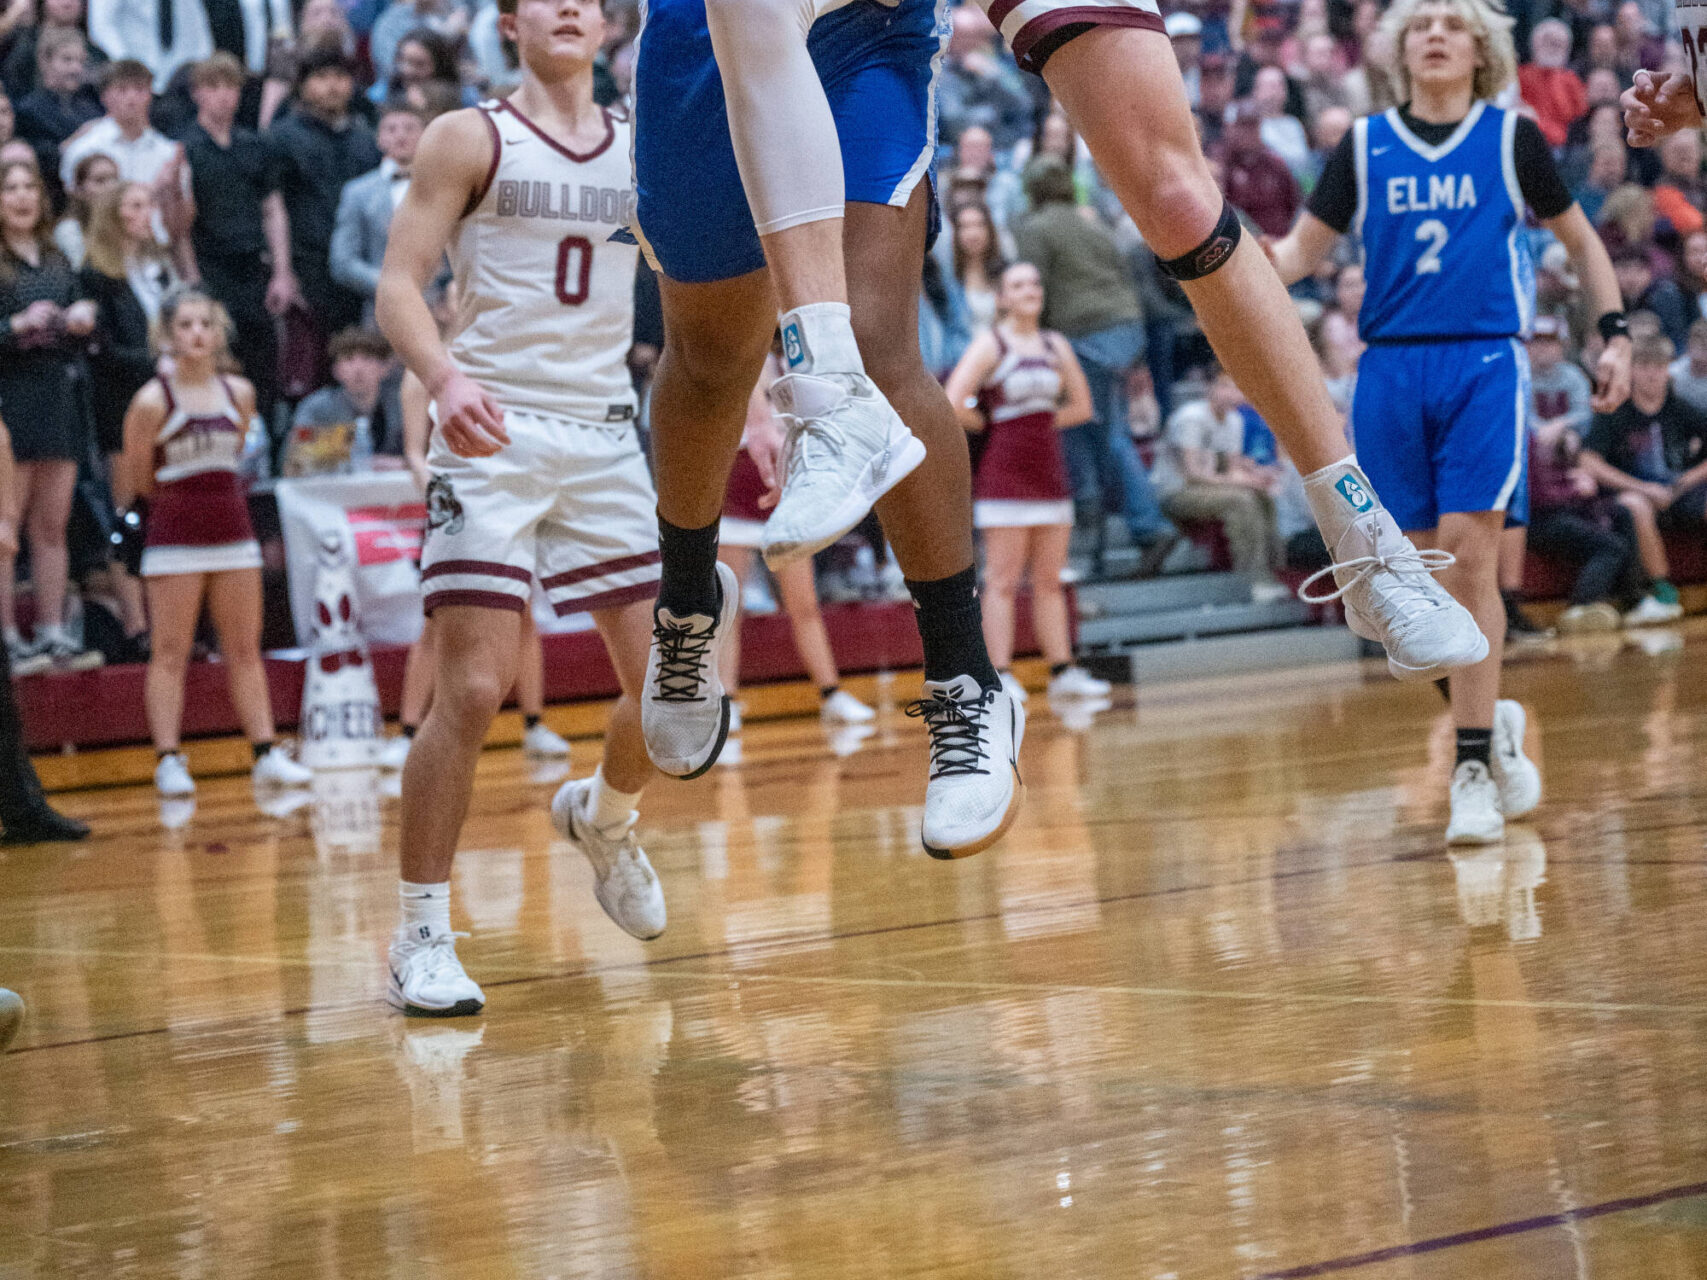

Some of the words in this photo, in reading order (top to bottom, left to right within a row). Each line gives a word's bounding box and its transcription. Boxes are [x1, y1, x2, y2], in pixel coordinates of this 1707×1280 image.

[1387, 173, 1477, 214] ELMA
[555, 234, 594, 307] 0
[1414, 219, 1450, 275] 2
